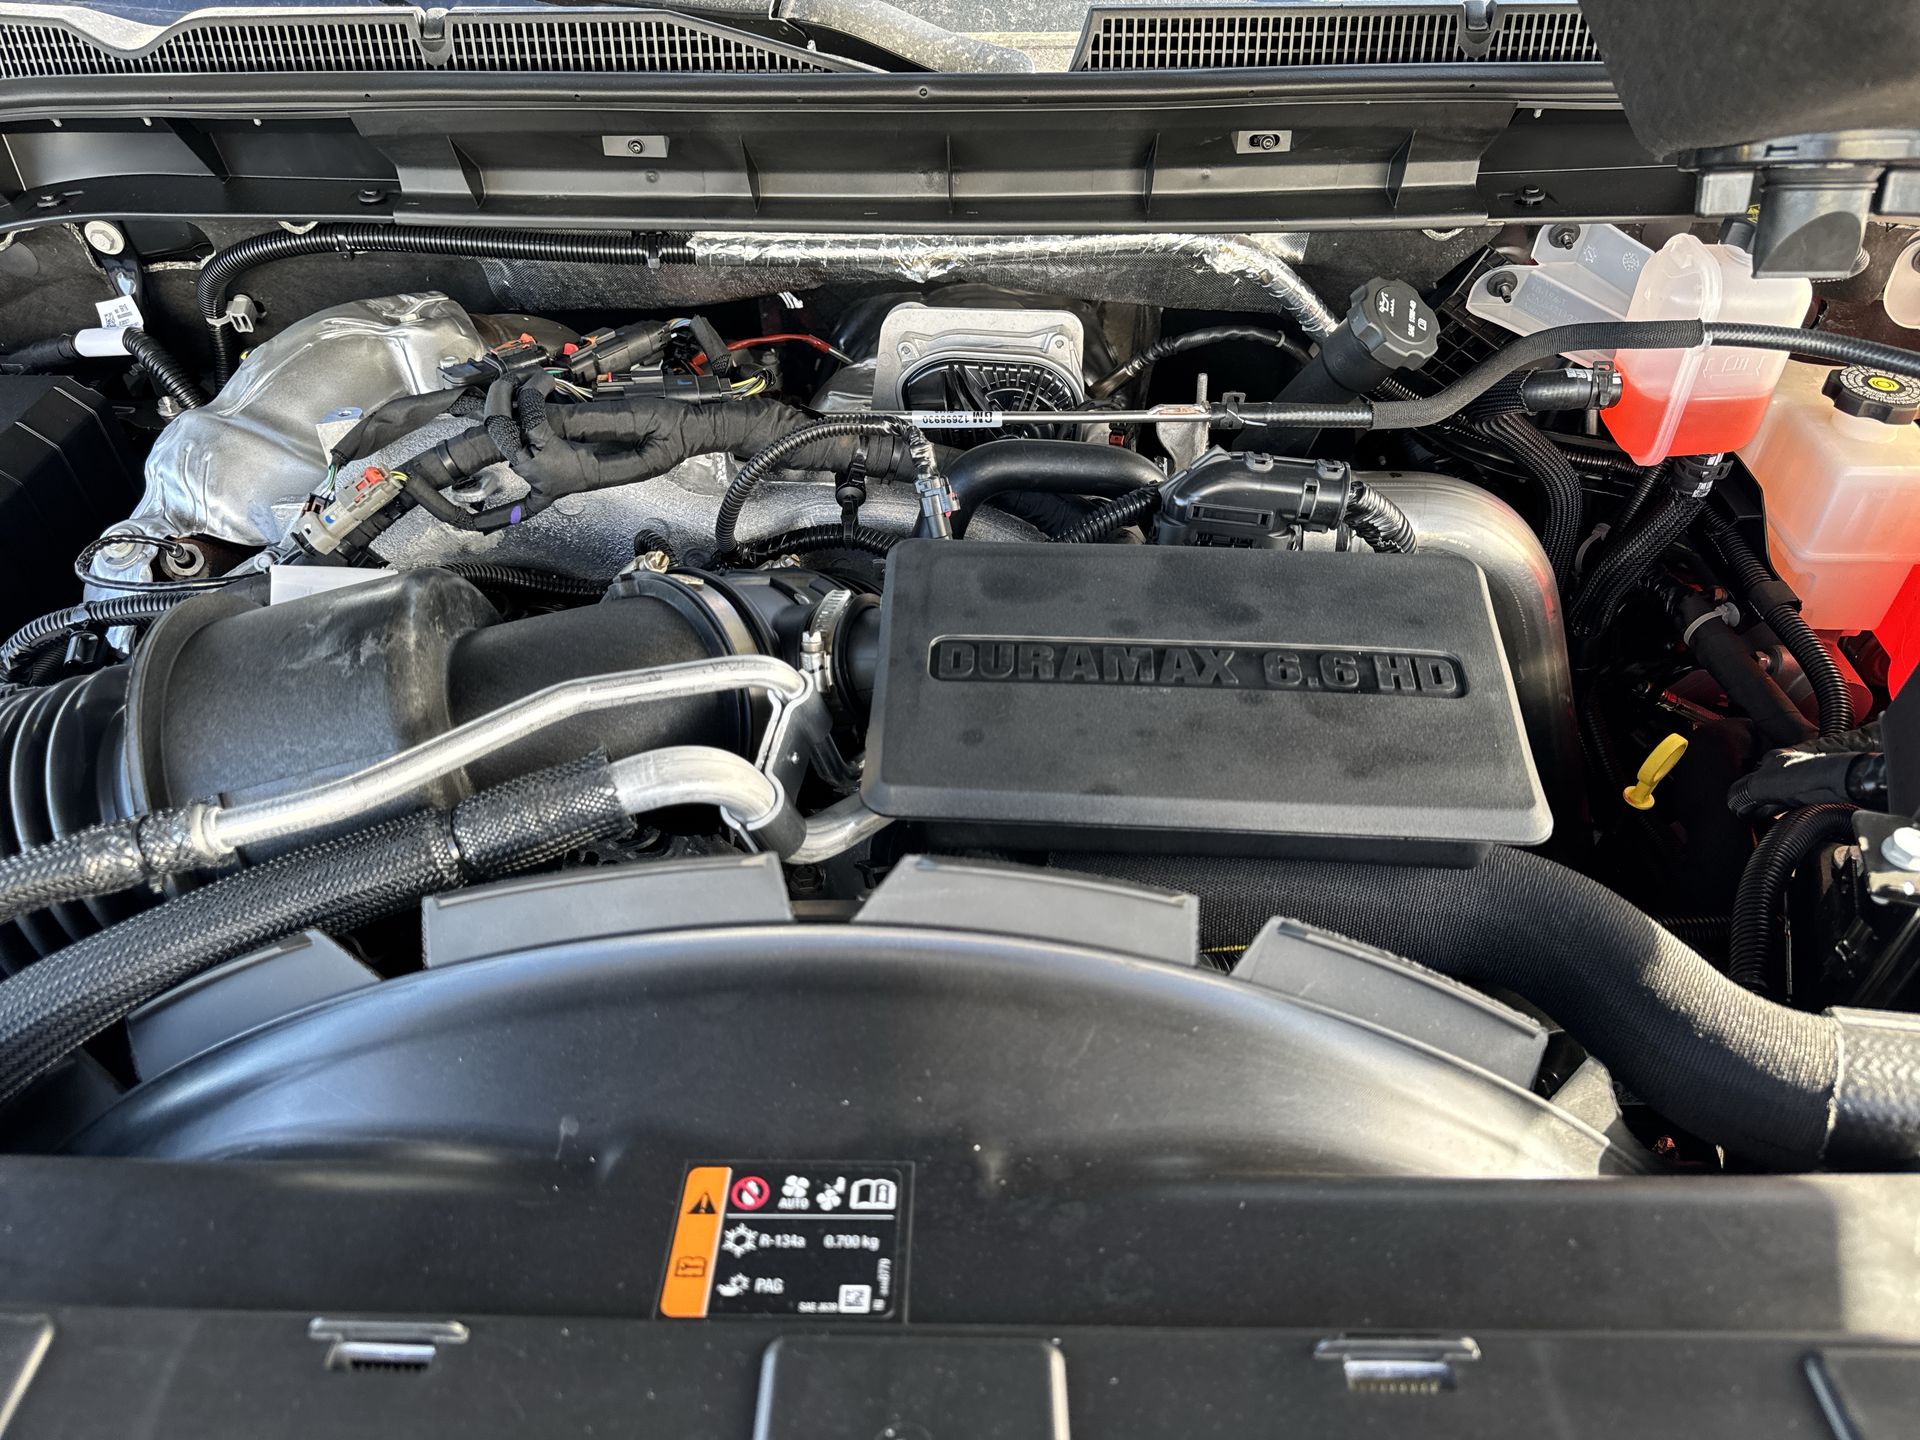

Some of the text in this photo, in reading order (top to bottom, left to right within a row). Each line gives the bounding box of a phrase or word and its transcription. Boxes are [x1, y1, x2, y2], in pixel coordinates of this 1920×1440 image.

[972, 411, 993, 423] GM
[937, 642, 1457, 693] DURAMAX 6.6 HD
[778, 1197, 809, 1210] AUTO
[758, 1233, 881, 1251] R-134a 0.700 kg
[754, 1278, 785, 1295] PAG
